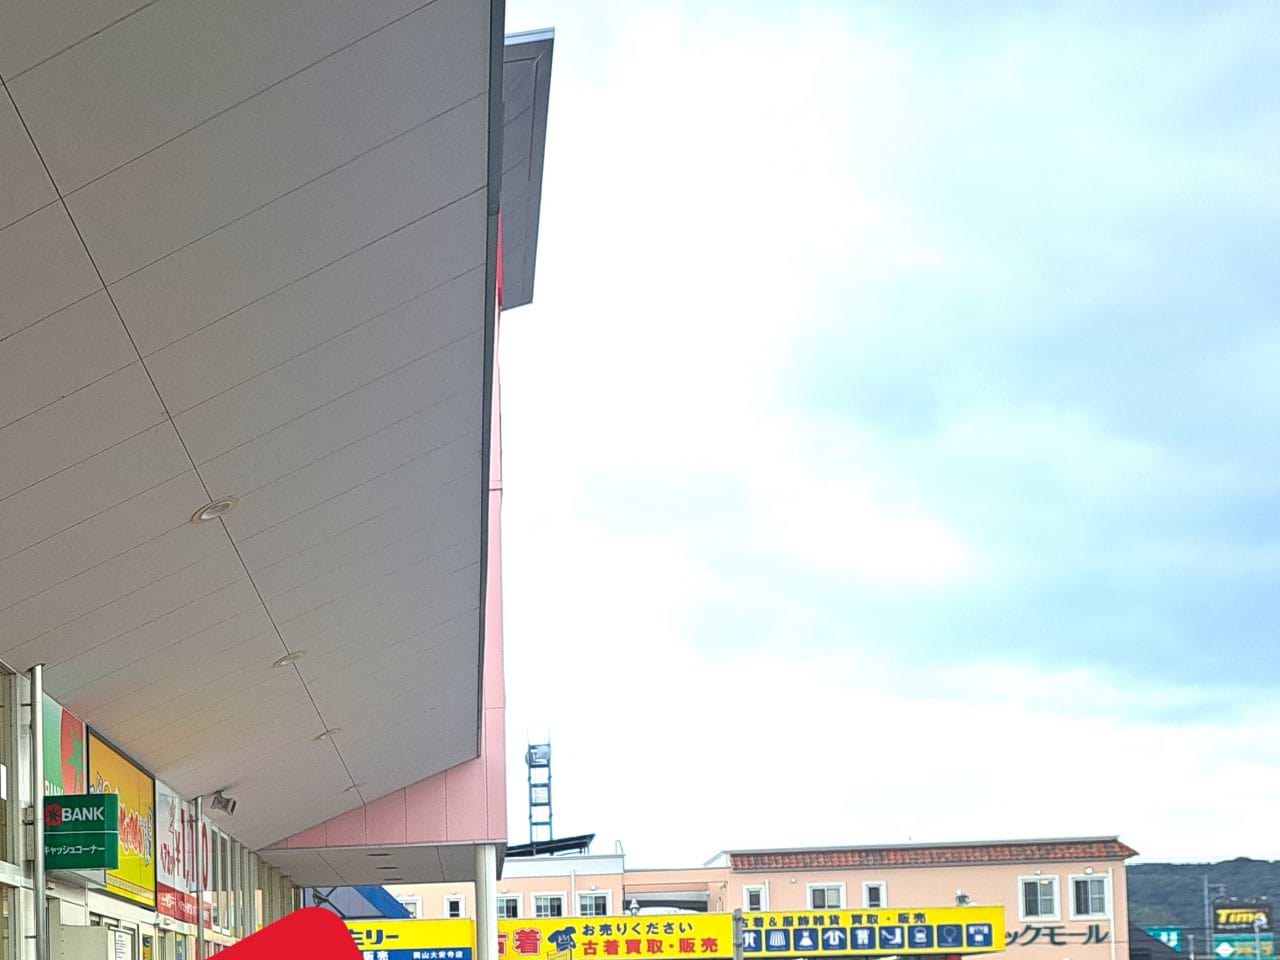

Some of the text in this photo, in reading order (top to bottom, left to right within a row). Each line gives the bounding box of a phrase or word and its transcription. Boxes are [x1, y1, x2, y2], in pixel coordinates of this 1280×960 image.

[62, 806, 105, 821] BANK
[45, 844, 105, 856] キャッシュコーナー
[582, 921, 693, 936] お売りください
[582, 938, 719, 956] 古着買取・販売
